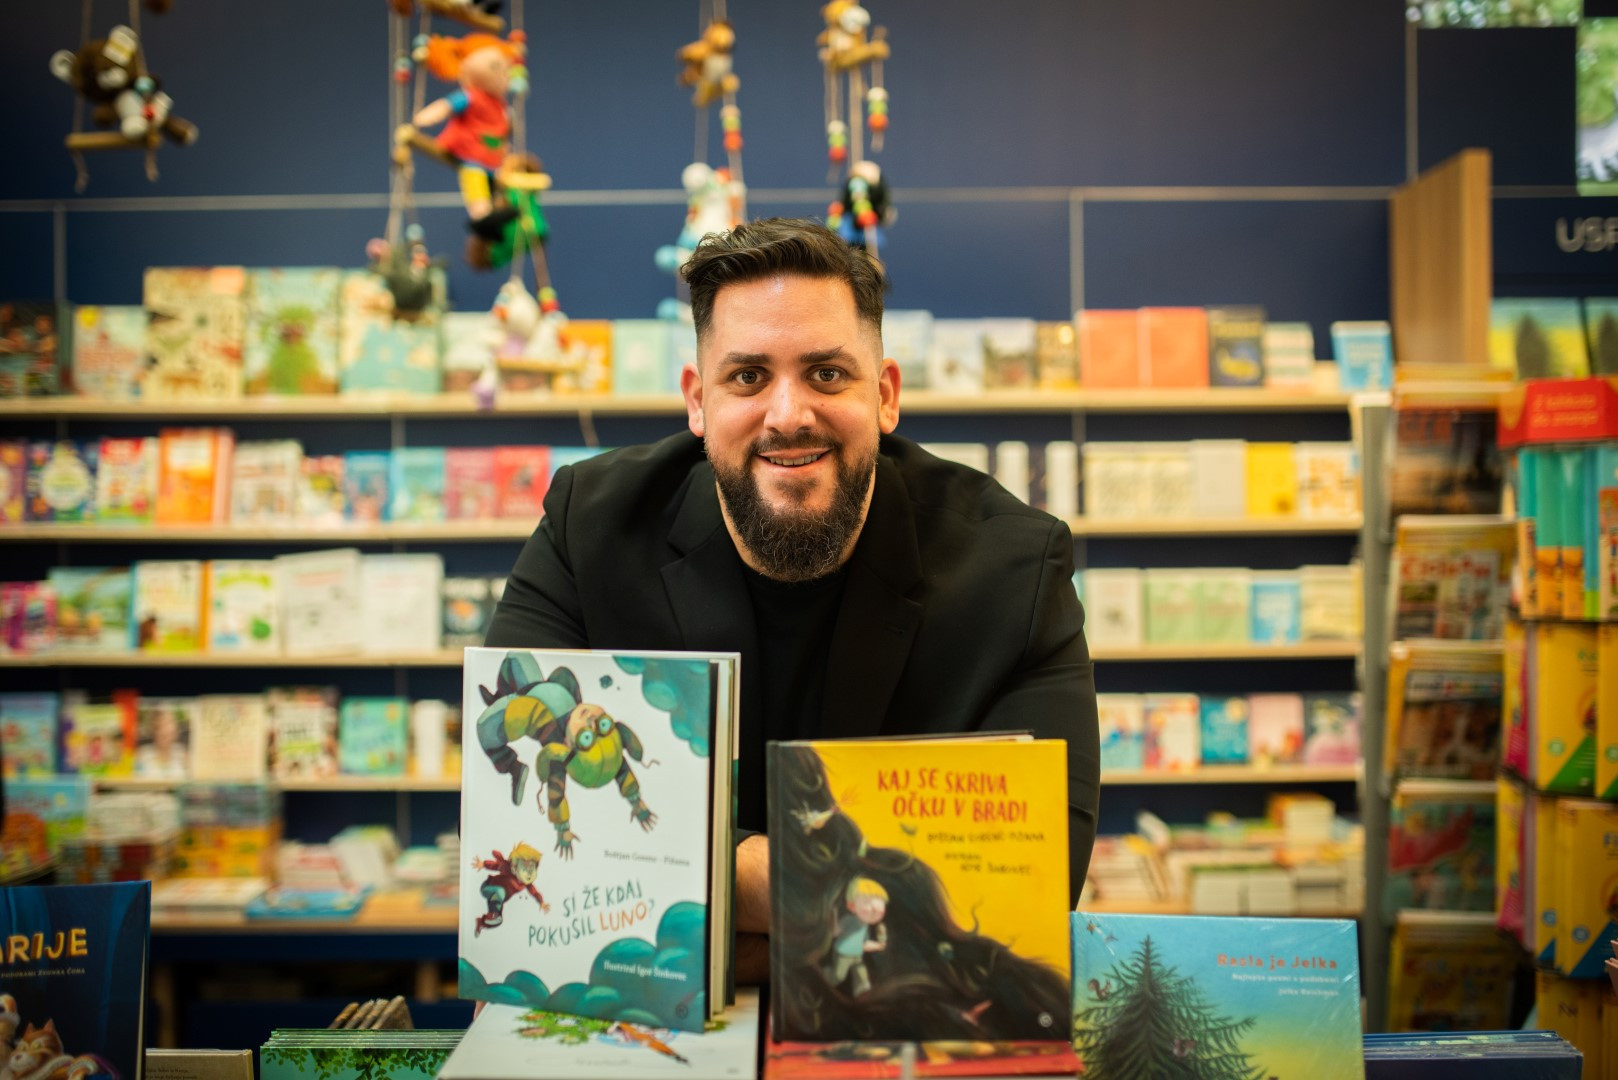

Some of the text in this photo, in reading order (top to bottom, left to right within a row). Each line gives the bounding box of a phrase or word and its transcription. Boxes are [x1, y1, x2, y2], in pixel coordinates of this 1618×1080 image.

[878, 767, 1007, 796] KAJ SE SKRIVA
[893, 791, 1028, 823] OČKU V BRADI
[563, 880, 643, 918] SI ŽE KDAJ
[528, 916, 595, 947] POKUSIL
